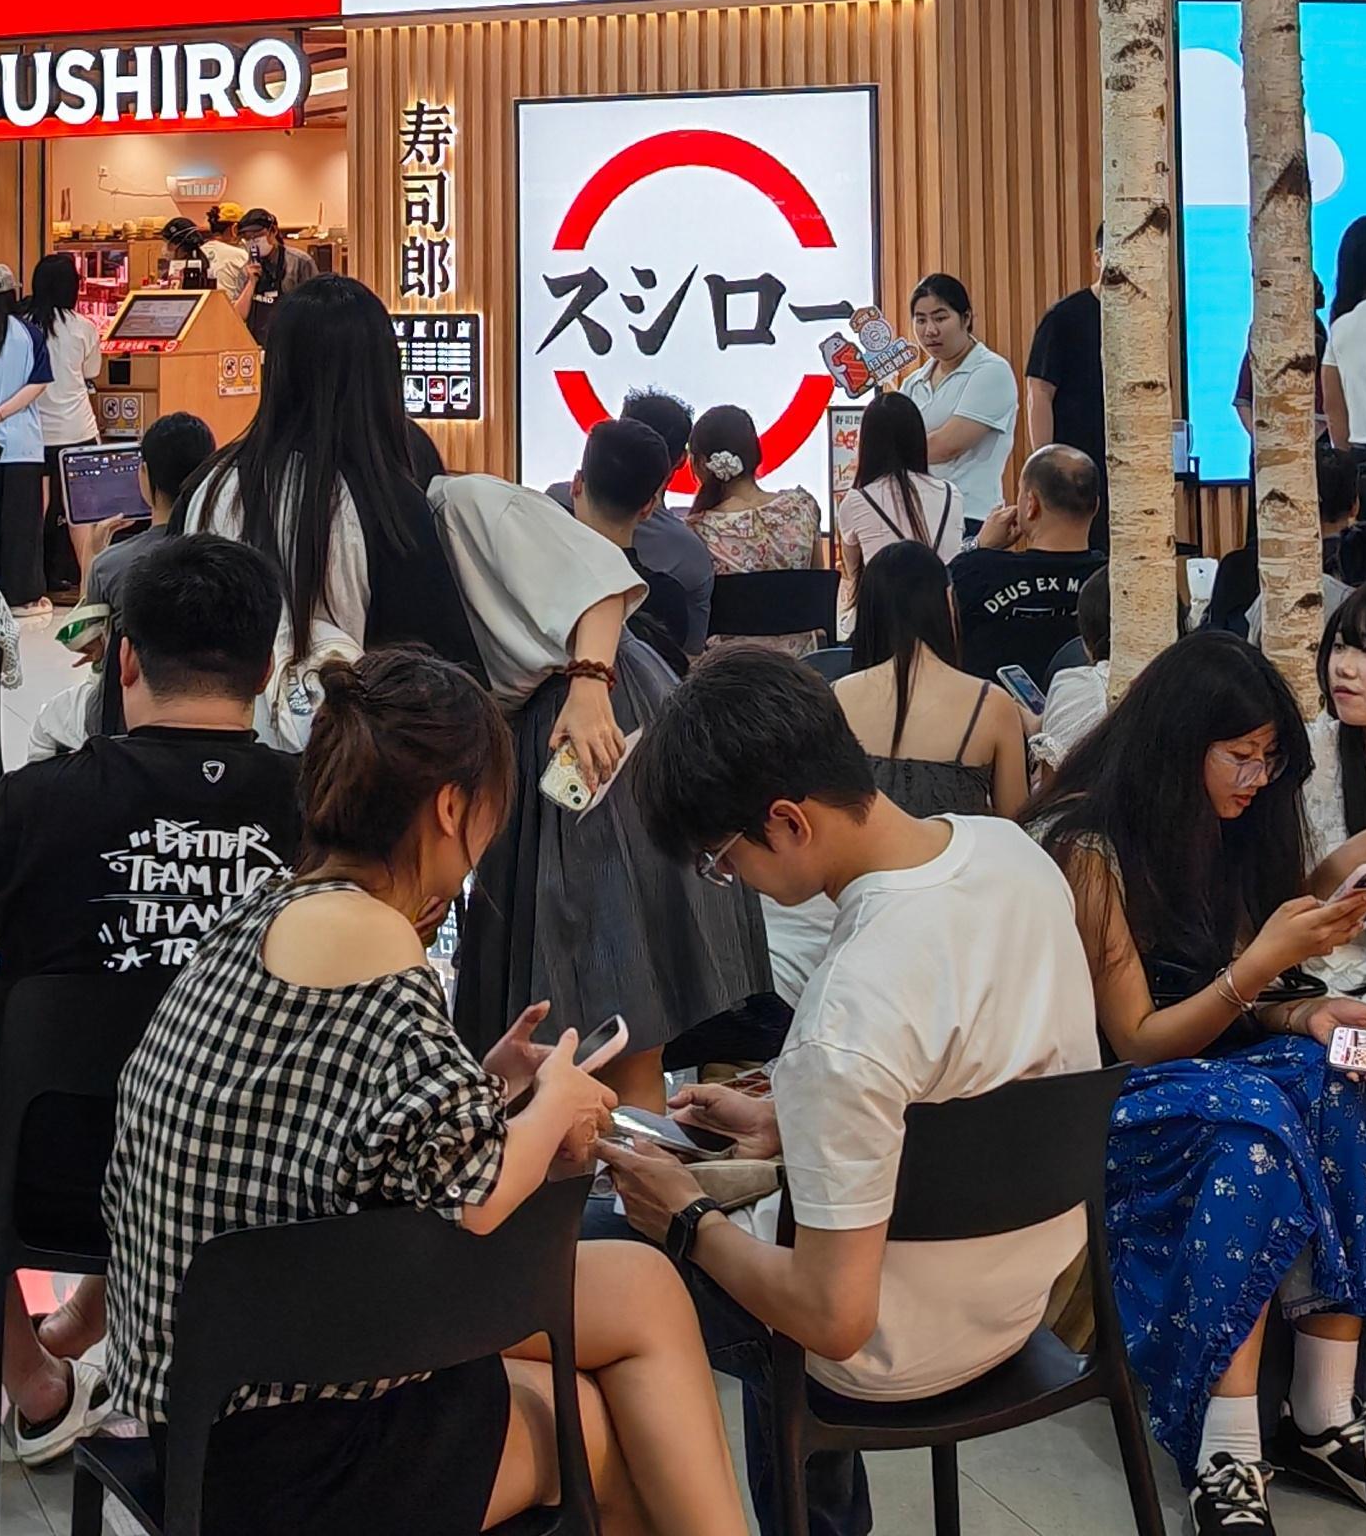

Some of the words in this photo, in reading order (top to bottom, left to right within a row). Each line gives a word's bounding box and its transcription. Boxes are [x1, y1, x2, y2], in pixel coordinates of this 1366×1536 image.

[399, 101, 453, 299] 寿司郎
[535, 264, 855, 356] スシロー
[983, 580, 1031, 614] DEUS
[1036, 577, 1060, 592] EX
[117, 854, 213, 897] TEAM
[219, 858, 276, 900] UP
